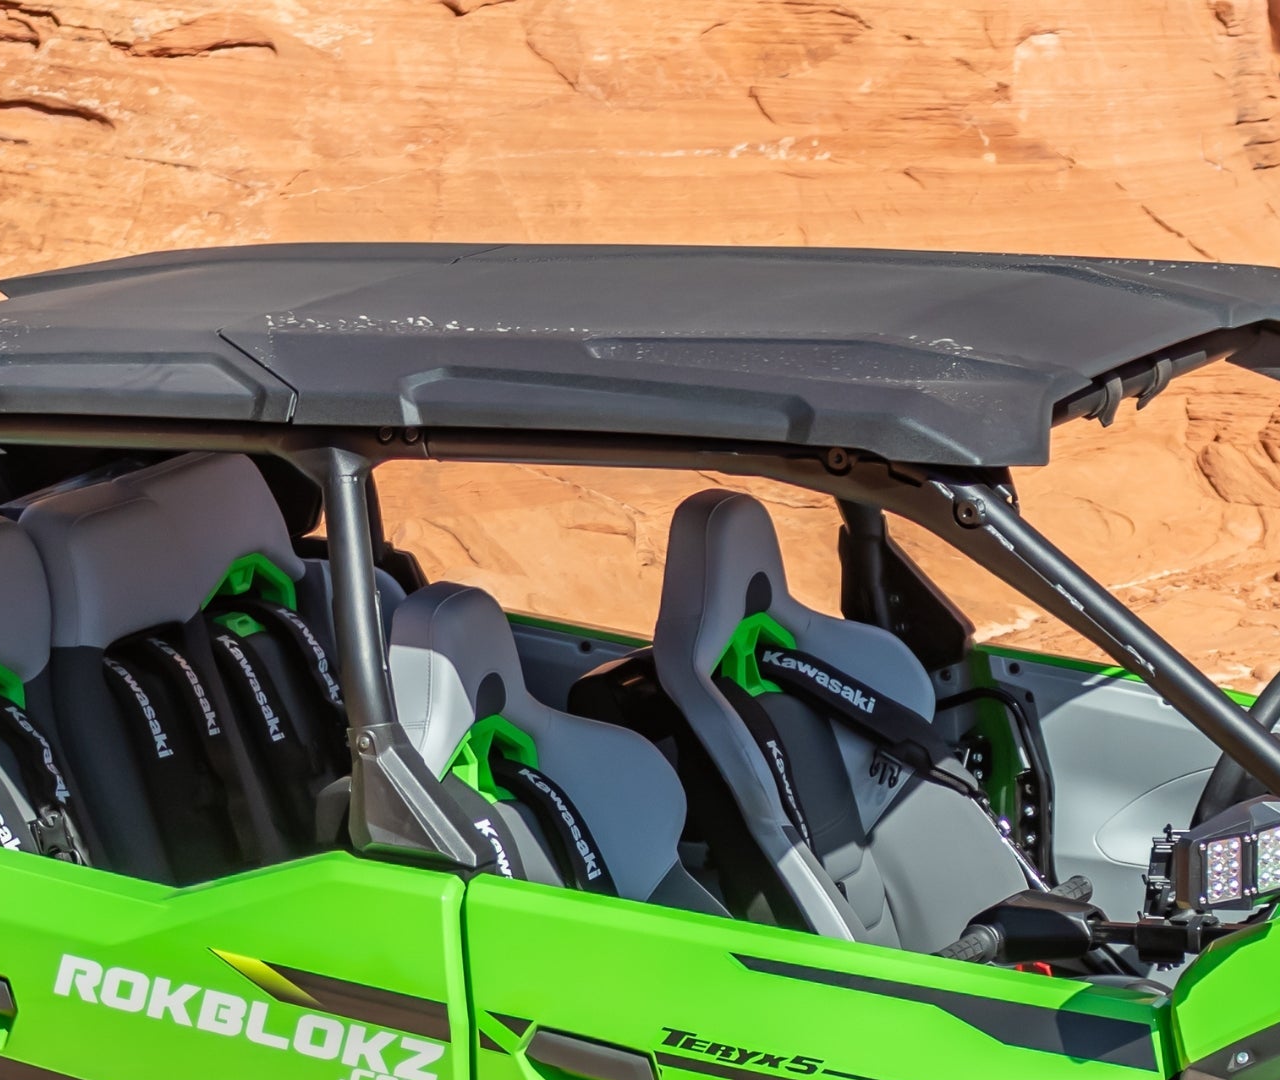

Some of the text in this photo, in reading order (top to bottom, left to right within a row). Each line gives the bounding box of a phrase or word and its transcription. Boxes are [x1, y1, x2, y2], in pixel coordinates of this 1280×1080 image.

[103, 657, 174, 758] Kawasaki
[147, 637, 221, 736] Kawasaki
[216, 635, 285, 742] Kawasaki
[763, 650, 876, 714] Kawasaki
[4, 706, 70, 804] Kawasak
[518, 768, 602, 881] Kawasaki
